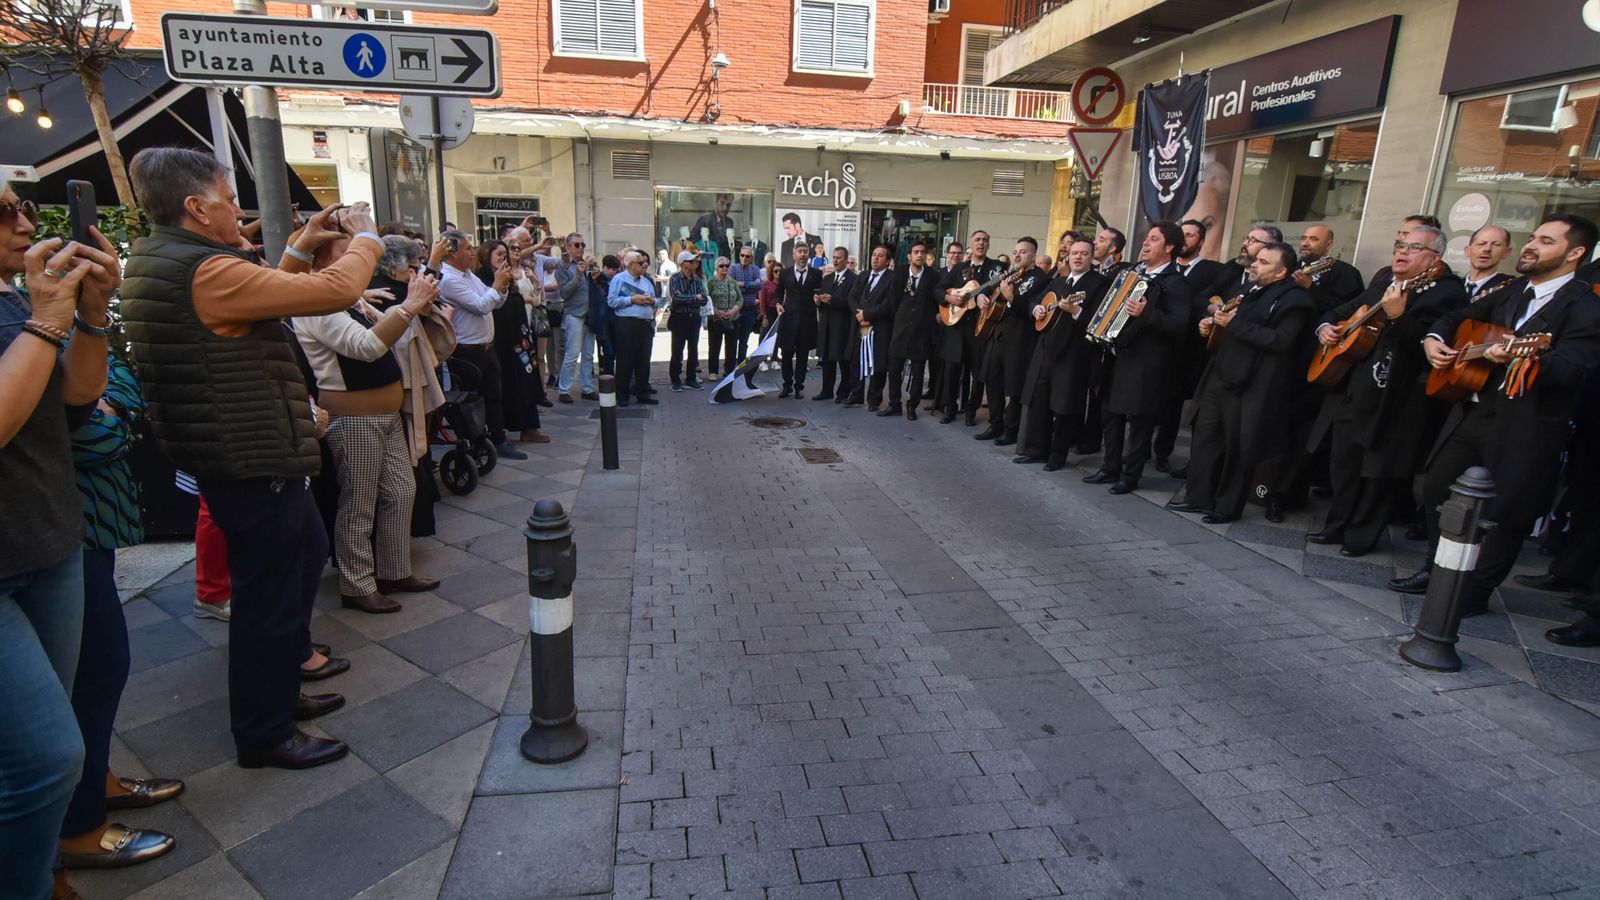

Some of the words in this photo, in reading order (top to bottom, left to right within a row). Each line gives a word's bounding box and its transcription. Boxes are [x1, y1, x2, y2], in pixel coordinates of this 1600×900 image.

[179, 28, 323, 47] ayuntamiento
[181, 49, 254, 72] Plaza
[269, 54, 325, 75] Alta
[1252, 80, 1290, 97] Centros
[1291, 67, 1342, 89] Auditivos
[1250, 89, 1316, 112] Profesionales
[493, 156, 506, 170] 17
[1158, 171, 1178, 180] LISBOA
[484, 199, 518, 209] Alfonso
[520, 201, 532, 209] XI
